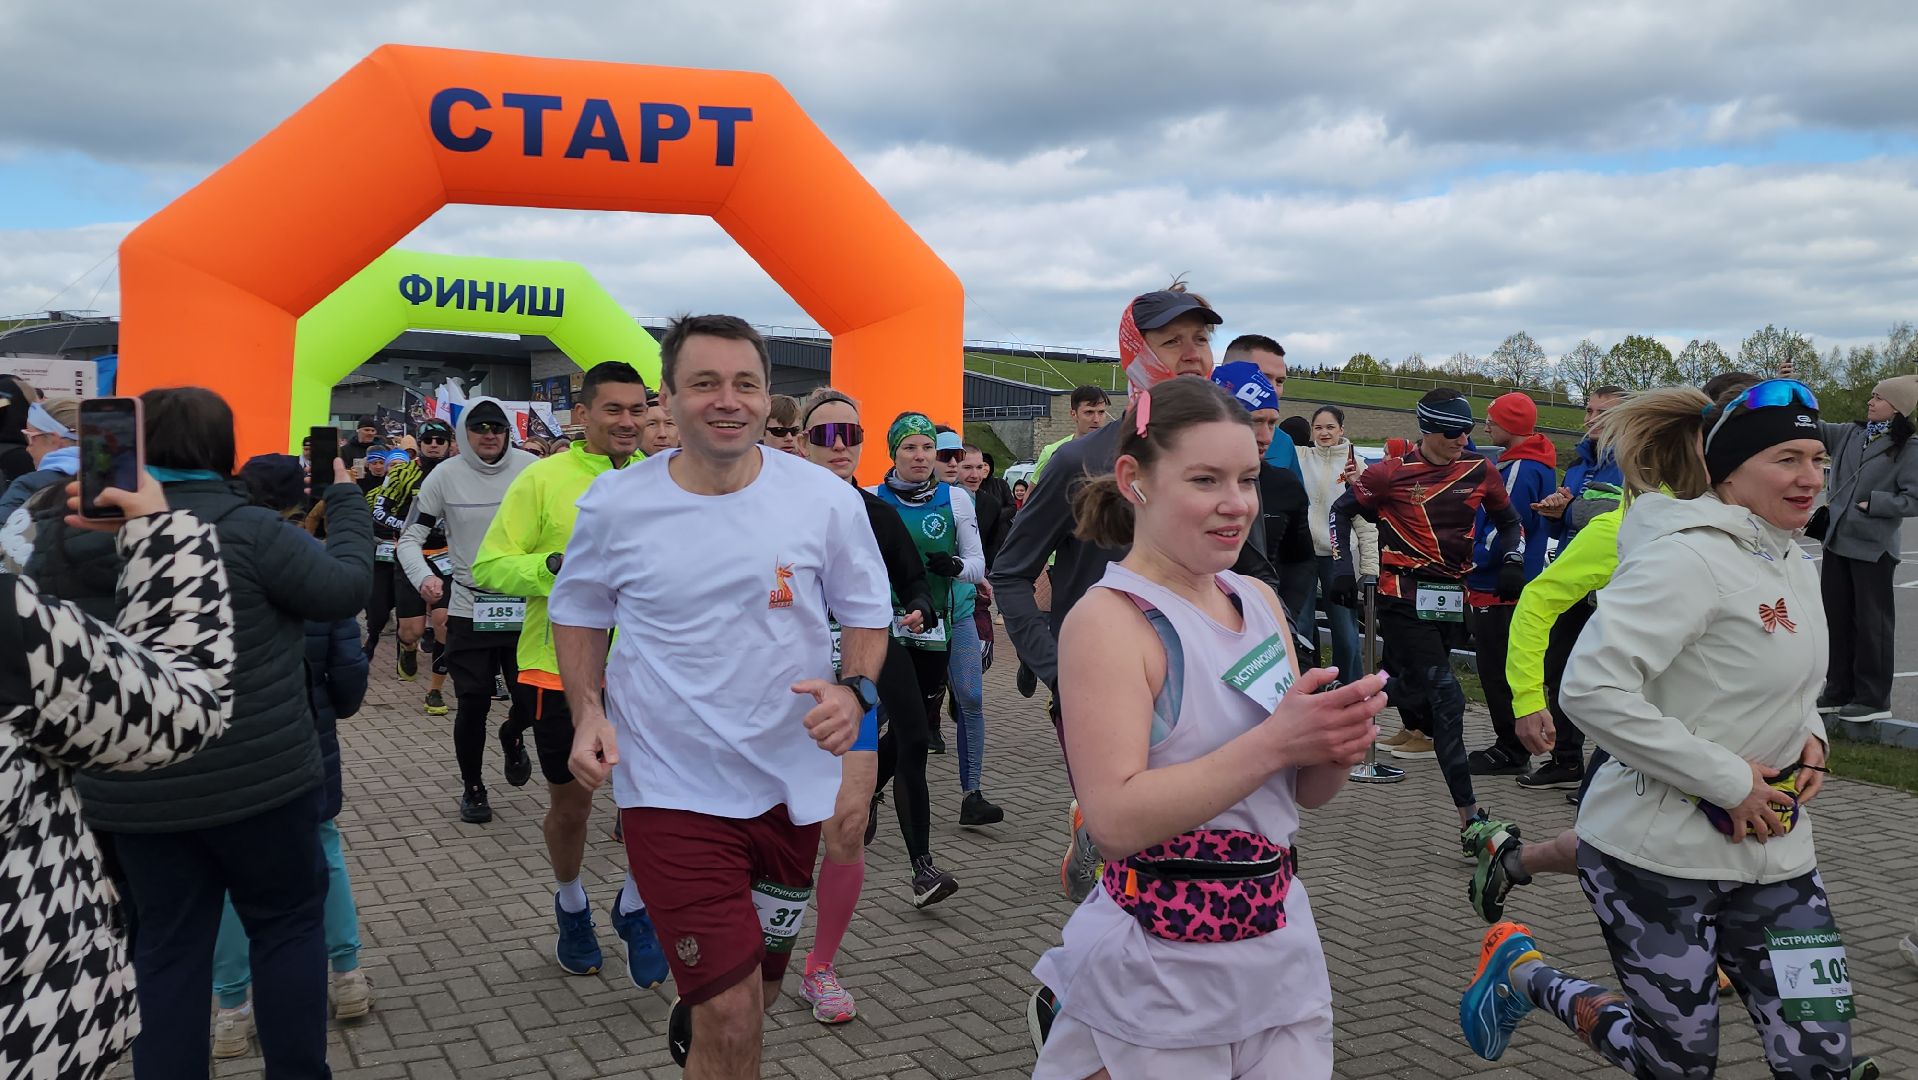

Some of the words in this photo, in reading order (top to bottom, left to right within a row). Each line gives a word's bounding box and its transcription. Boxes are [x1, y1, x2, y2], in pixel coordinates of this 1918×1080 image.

[429, 87, 753, 167] СТАРТ
[399, 273, 565, 318] ФИНИШ
[1437, 595, 1446, 607] 9
[487, 606, 514, 618] 185
[769, 907, 803, 928] 37
[764, 936, 773, 946] 9
[1835, 999, 1845, 1014] 9
